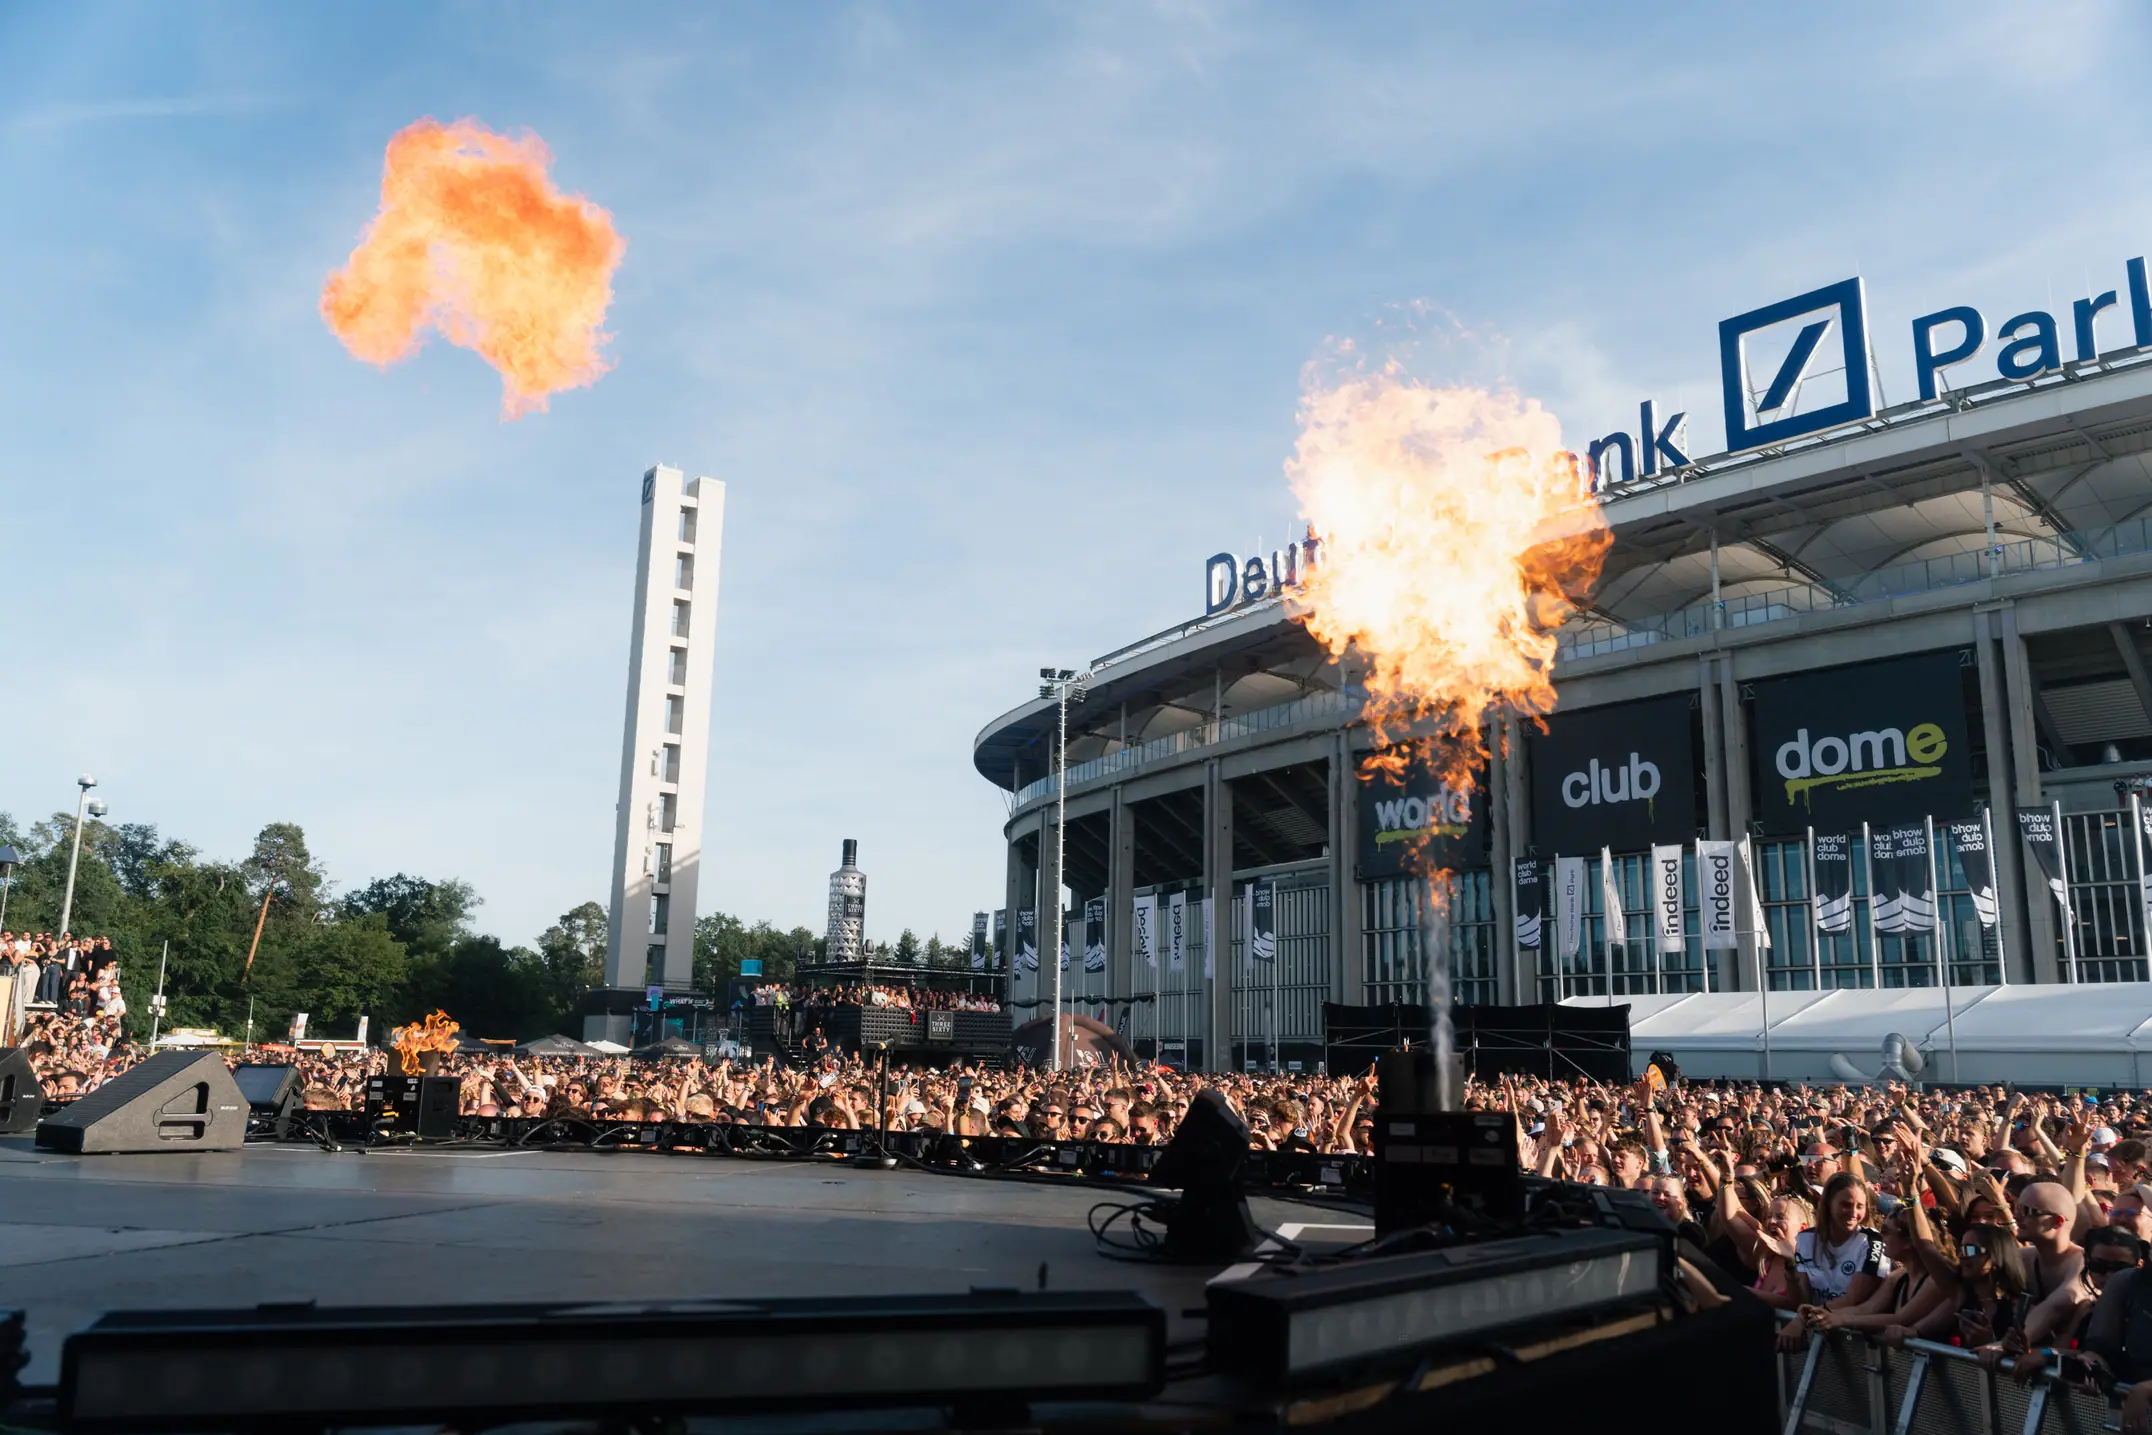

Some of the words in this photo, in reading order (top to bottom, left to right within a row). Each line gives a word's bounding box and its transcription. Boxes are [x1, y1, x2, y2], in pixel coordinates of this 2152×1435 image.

[1775, 723, 1948, 780] dome
[1562, 752, 1661, 808] club
[1375, 779, 1472, 831] world
[1817, 834, 1846, 844] world
[1817, 843, 1839, 852] club
[1817, 852, 1847, 861] dome
[1517, 861, 1537, 870] world
[1518, 869, 1532, 878] club
[1518, 877, 1539, 885] dome
[1661, 859, 1679, 936] indeed
[1708, 855, 1731, 931] indeed
